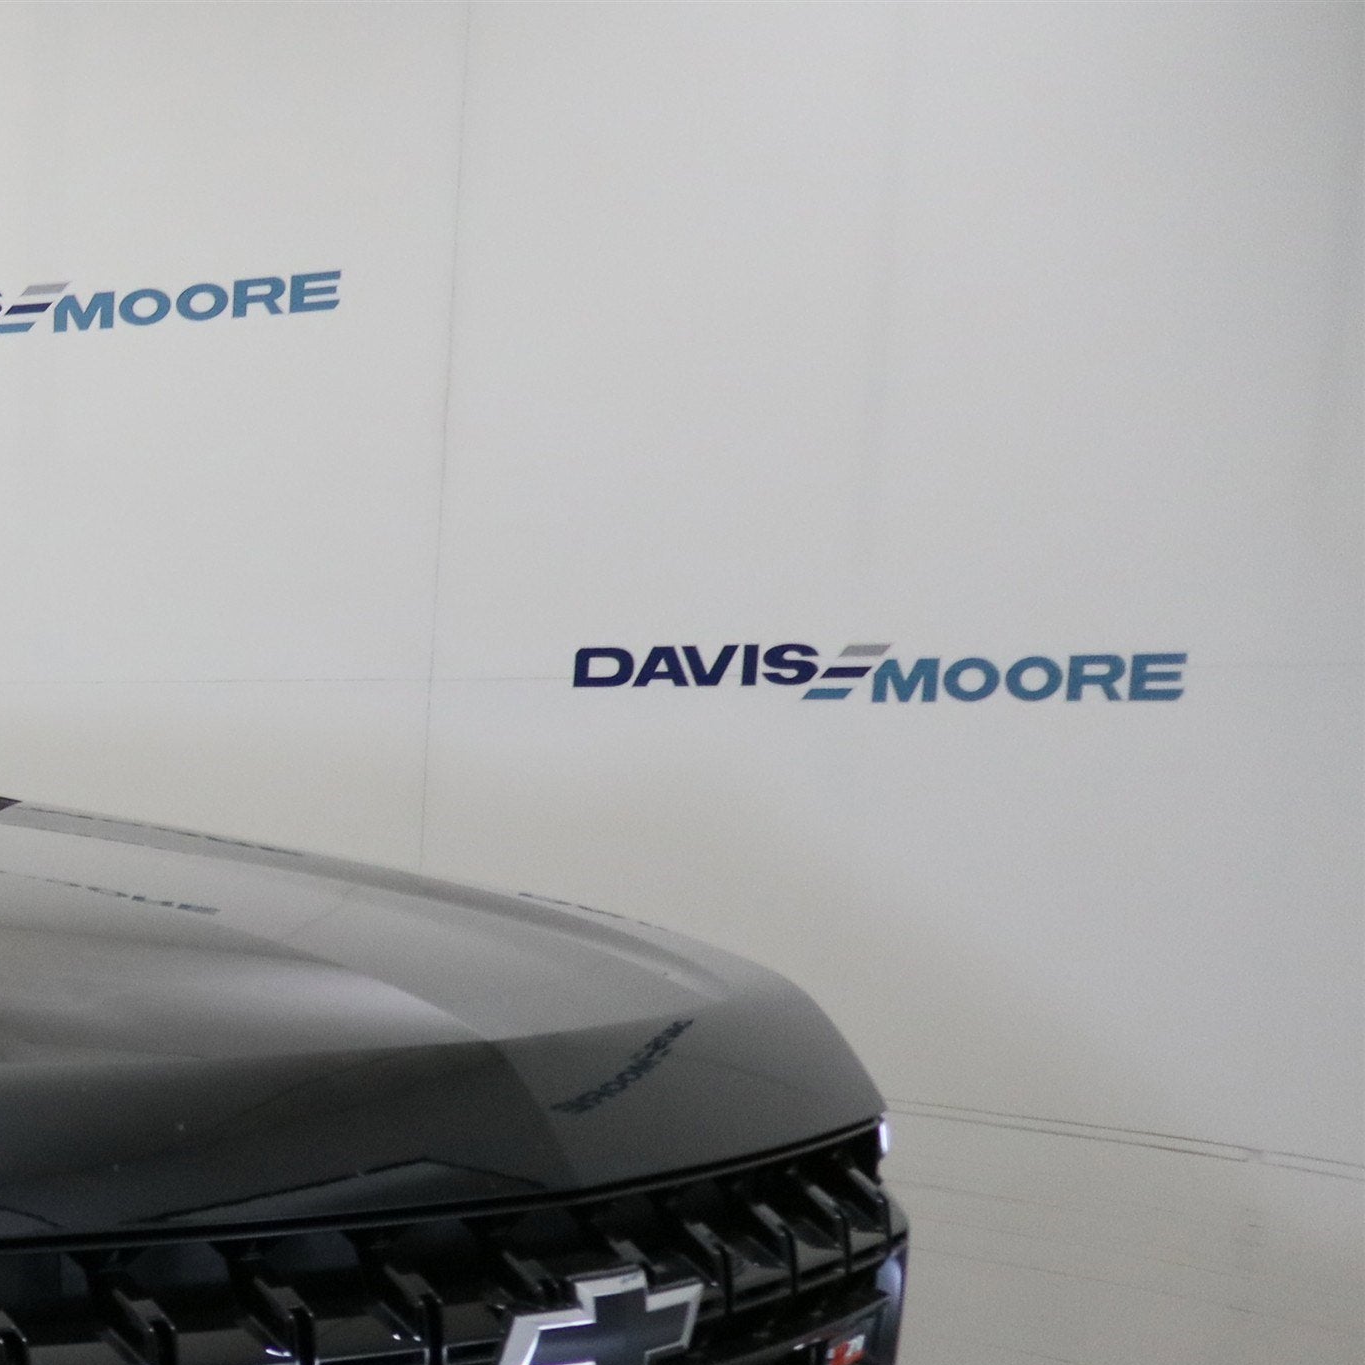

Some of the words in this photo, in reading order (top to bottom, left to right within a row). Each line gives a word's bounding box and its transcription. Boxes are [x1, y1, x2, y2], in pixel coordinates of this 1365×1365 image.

[52, 269, 343, 333] MOORE
[573, 643, 818, 687] DAVIS
[870, 653, 1187, 702] MOORE
